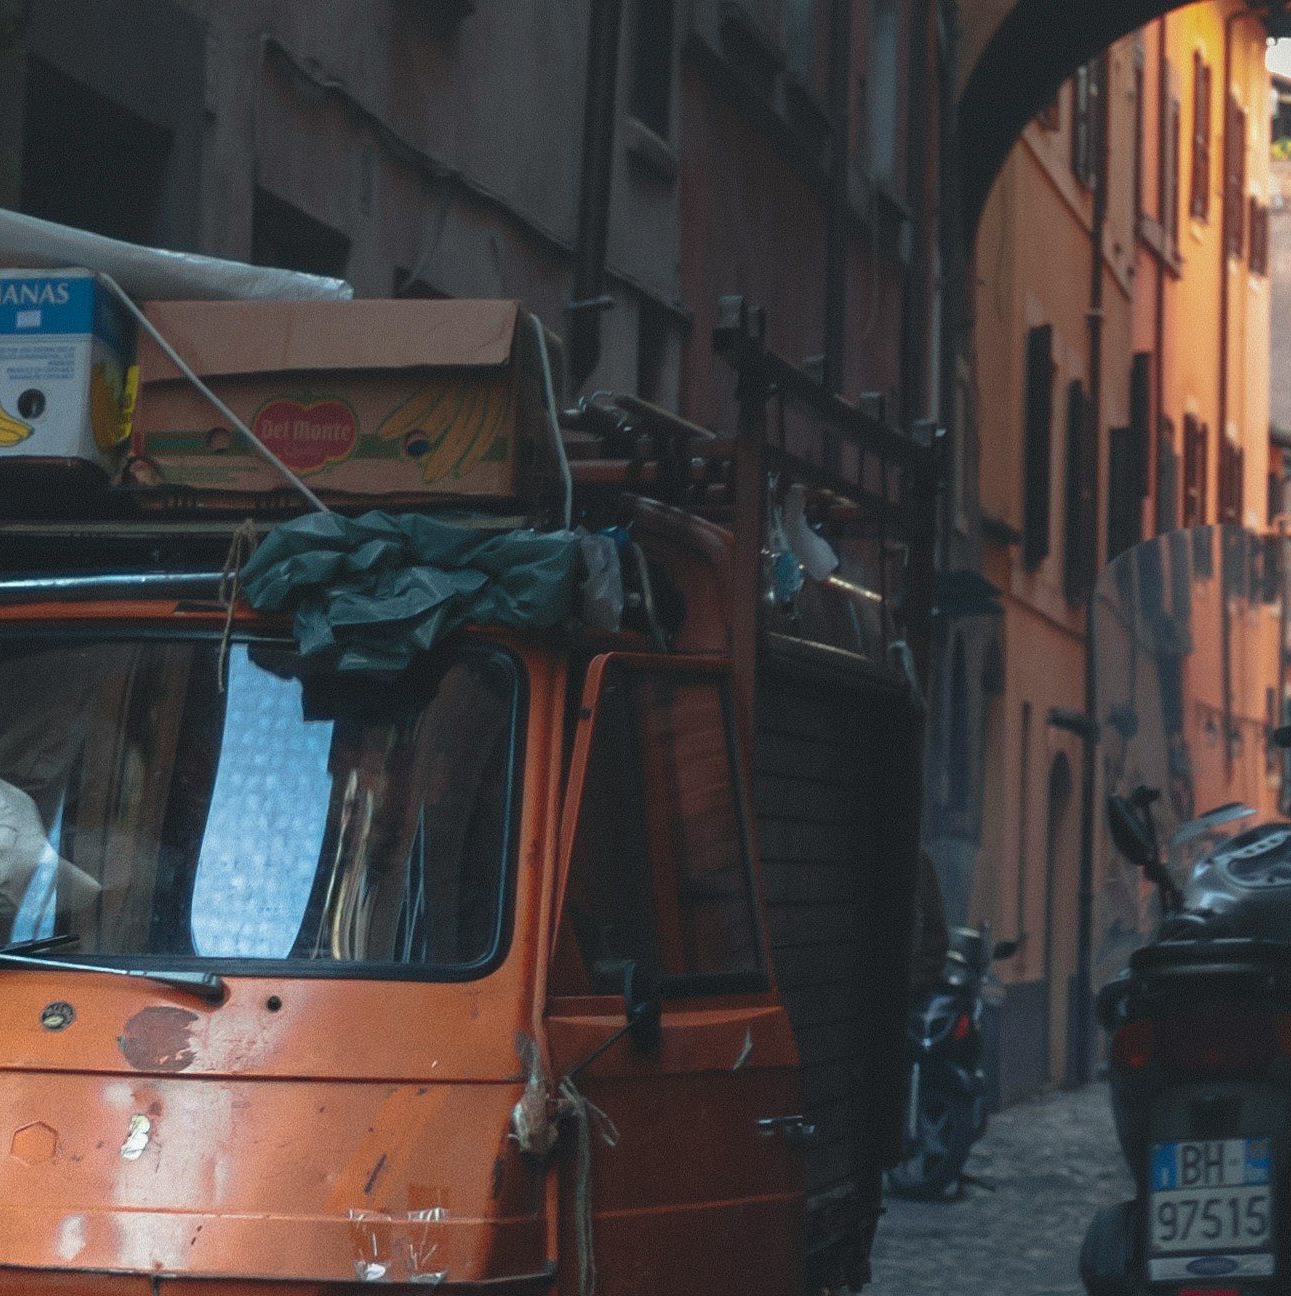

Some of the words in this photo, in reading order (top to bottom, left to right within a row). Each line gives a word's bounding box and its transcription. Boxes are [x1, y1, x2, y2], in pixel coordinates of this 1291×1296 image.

[261, 419, 290, 439] Del
[293, 420, 352, 442] Monte
[1182, 1143, 1224, 1186] BH
[1157, 1195, 1267, 1241] 97515
